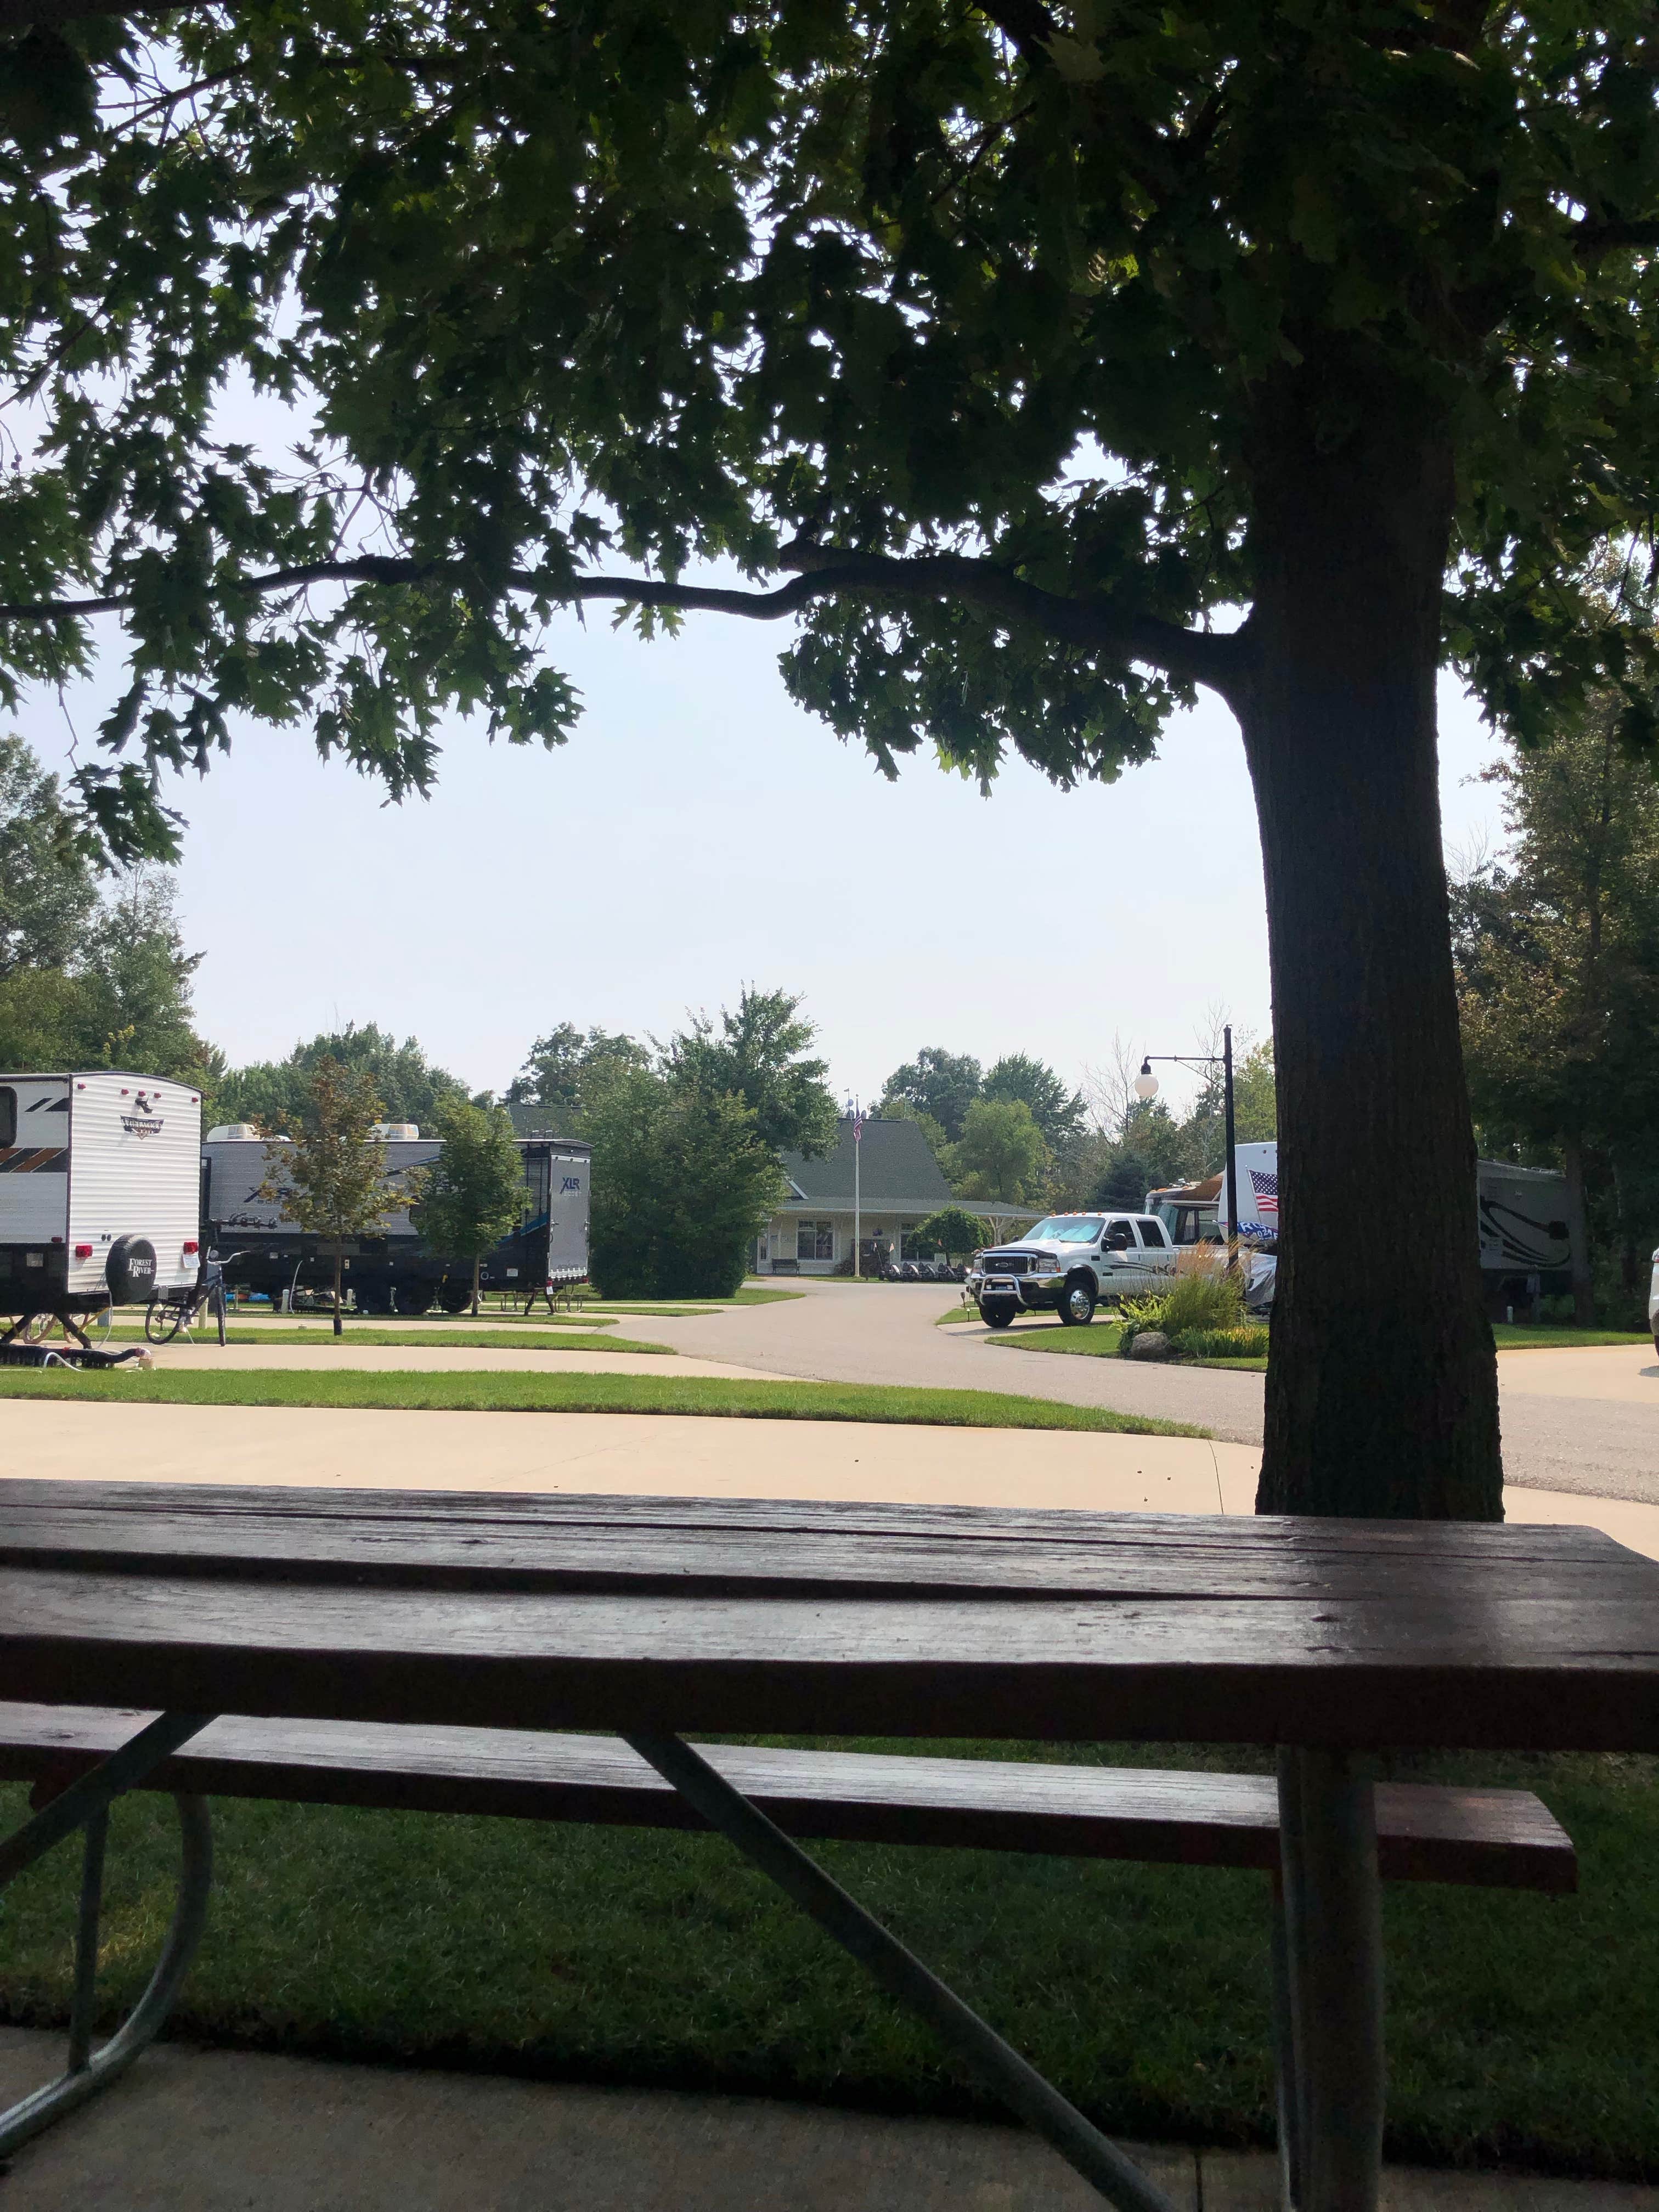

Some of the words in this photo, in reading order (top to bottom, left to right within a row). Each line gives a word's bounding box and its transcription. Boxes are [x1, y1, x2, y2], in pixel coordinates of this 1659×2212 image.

[560, 1177, 580, 1194] XLR
[128, 1258, 153, 1271] FOREST
[133, 1266, 151, 1277] RIVER
